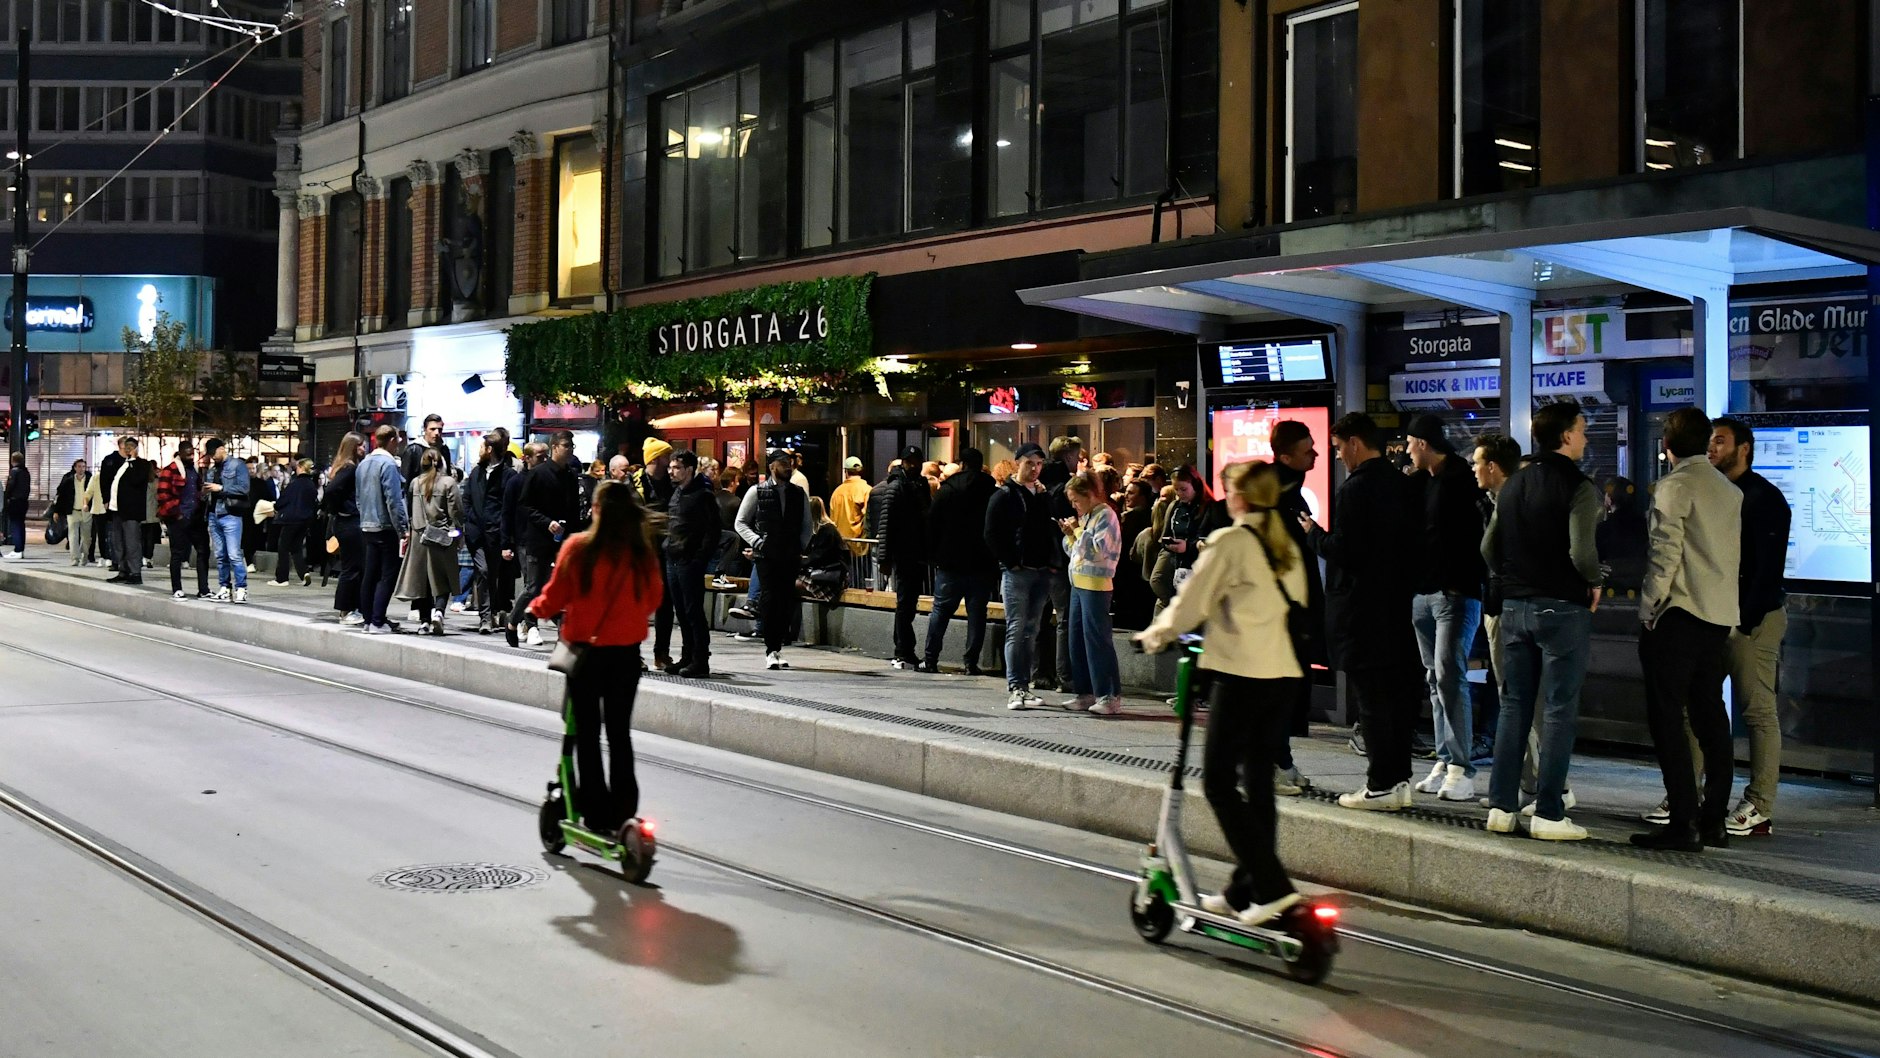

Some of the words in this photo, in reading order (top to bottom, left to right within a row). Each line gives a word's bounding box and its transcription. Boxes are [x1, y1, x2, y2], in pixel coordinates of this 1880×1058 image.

[26, 302, 84, 325] ormal
[1729, 315, 1750, 333] en
[1758, 308, 1814, 332] Glade
[658, 312, 781, 354] STORGATA
[799, 305, 828, 339] 26
[1409, 335, 1472, 357] Storgata
[1405, 378, 1447, 394] KIOSK
[1451, 378, 1461, 392] &
[1465, 370, 1586, 392] INTETKAFE
